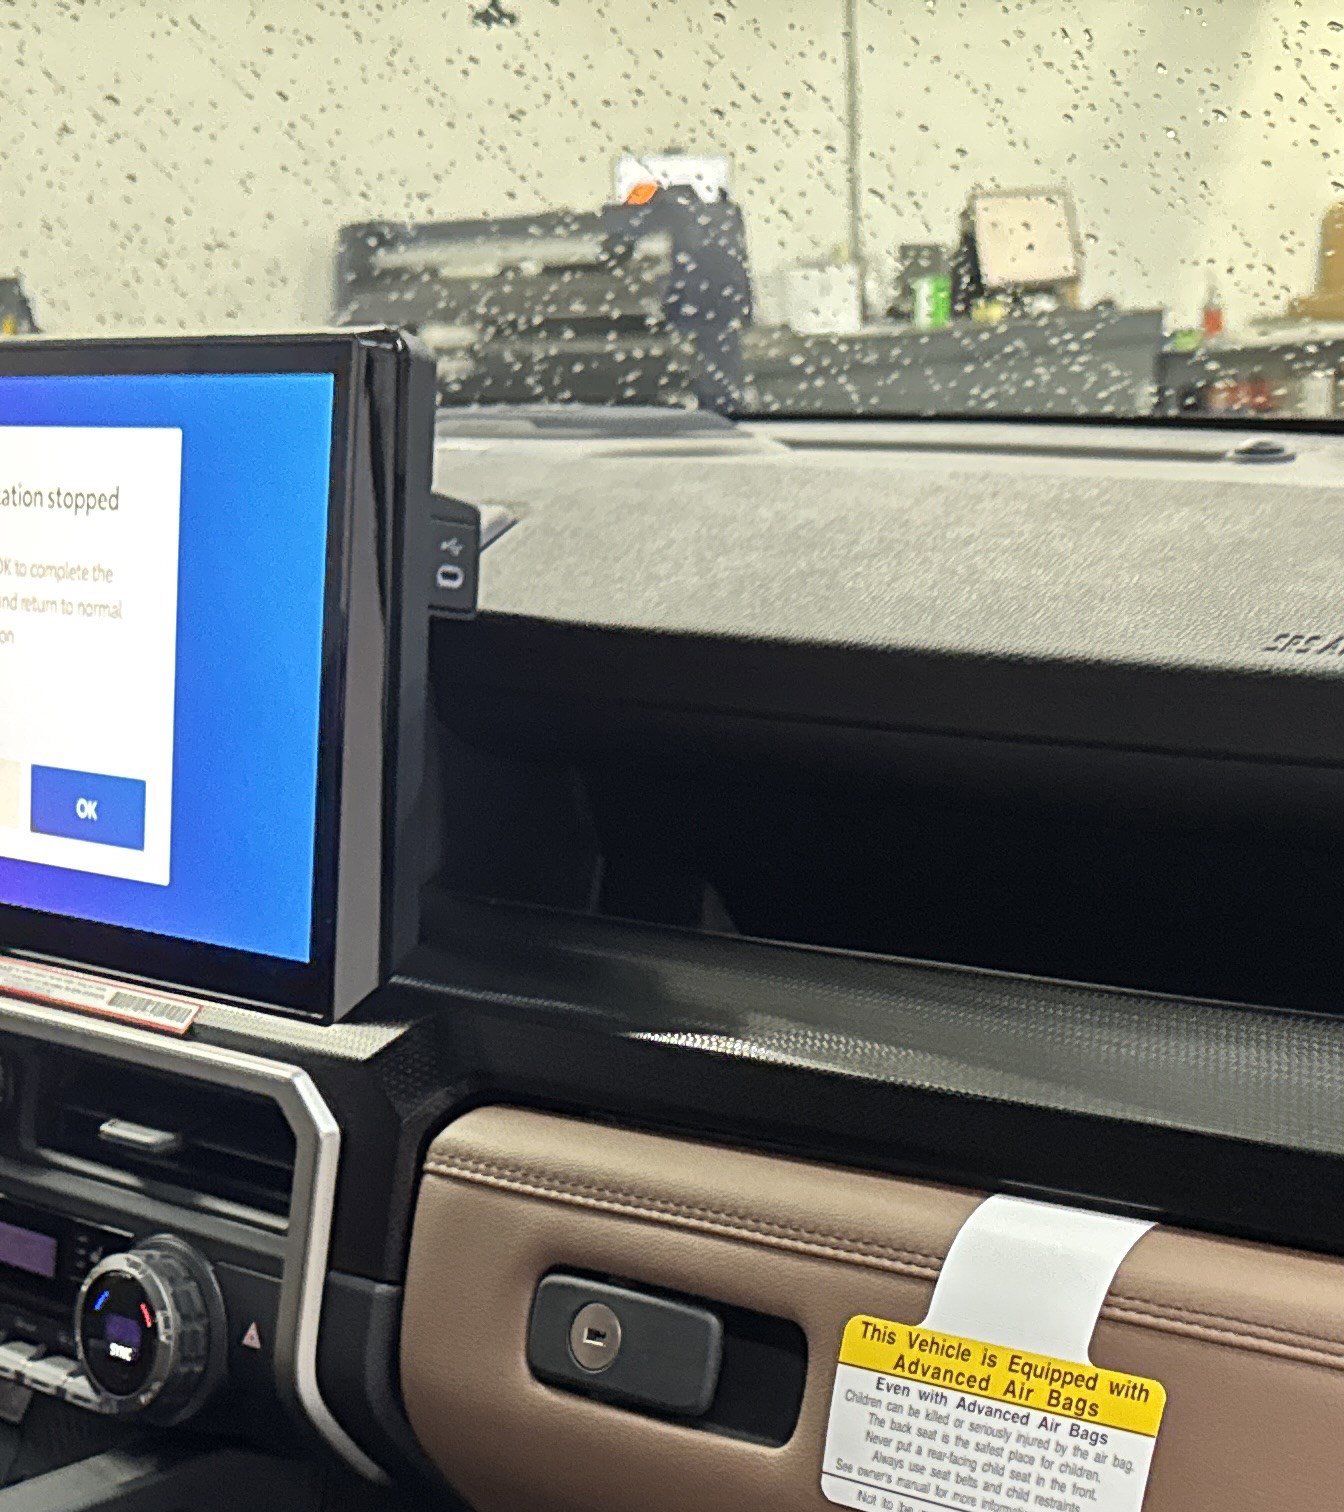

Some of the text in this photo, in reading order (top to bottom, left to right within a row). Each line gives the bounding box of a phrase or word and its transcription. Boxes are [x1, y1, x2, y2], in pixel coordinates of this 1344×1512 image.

[48, 485, 120, 516] stopped
[14, 560, 27, 578] to
[29, 562, 89, 583] complete
[92, 564, 114, 583] the
[21, 597, 58, 614] return
[61, 599, 74, 615] to
[77, 600, 123, 620] normal
[75, 797, 98, 821] OK
[862, 1321, 1149, 1403] This Vehicle is Equipped with
[893, 1354, 1099, 1417] Advanced Air Bags
[844, 1389, 882, 1409] Children
[885, 1402, 903, 1414] can
[908, 1404, 920, 1418] be
[925, 1409, 950, 1425] killed
[954, 1418, 965, 1429] or
[968, 1422, 1012, 1443] seriously
[1016, 1431, 1051, 1450] injured
[1054, 1440, 1068, 1457] by
[1073, 1445, 1089, 1460] the
[1094, 1452, 1108, 1464] air
[876, 1377, 1108, 1446] Even with Advanced Air Bags
[865, 1430, 893, 1447] Never
[896, 1441, 912, 1453] put
[915, 1445, 922, 1456] a
[927, 1448, 977, 1473] rear-facing
[982, 1462, 1005, 1477] child
[1009, 1470, 1031, 1484] seat
[1036, 1474, 1045, 1487] in
[1050, 1478, 1066, 1493] the
[869, 1412, 885, 1428] The
[890, 1418, 912, 1434] back
[916, 1427, 937, 1441] seat
[941, 1434, 949, 1444] is
[954, 1435, 970, 1449] the
[974, 1442, 1004, 1458] safest
[1007, 1449, 1035, 1465] place
[1040, 1456, 1055, 1470] for
[836, 1458, 853, 1473] See
[895, 1477, 931, 1494] manual
[934, 1485, 949, 1498] for
[951, 1492, 977, 1507] more
[857, 1490, 876, 1505] Not
[881, 1497, 893, 1510] to
[872, 1450, 904, 1470] Always
[908, 1462, 926, 1475] use
[929, 1468, 951, 1481] seat
[954, 1472, 978, 1488] belts
[982, 1481, 1002, 1495] and
[1006, 1486, 1030, 1502] child
